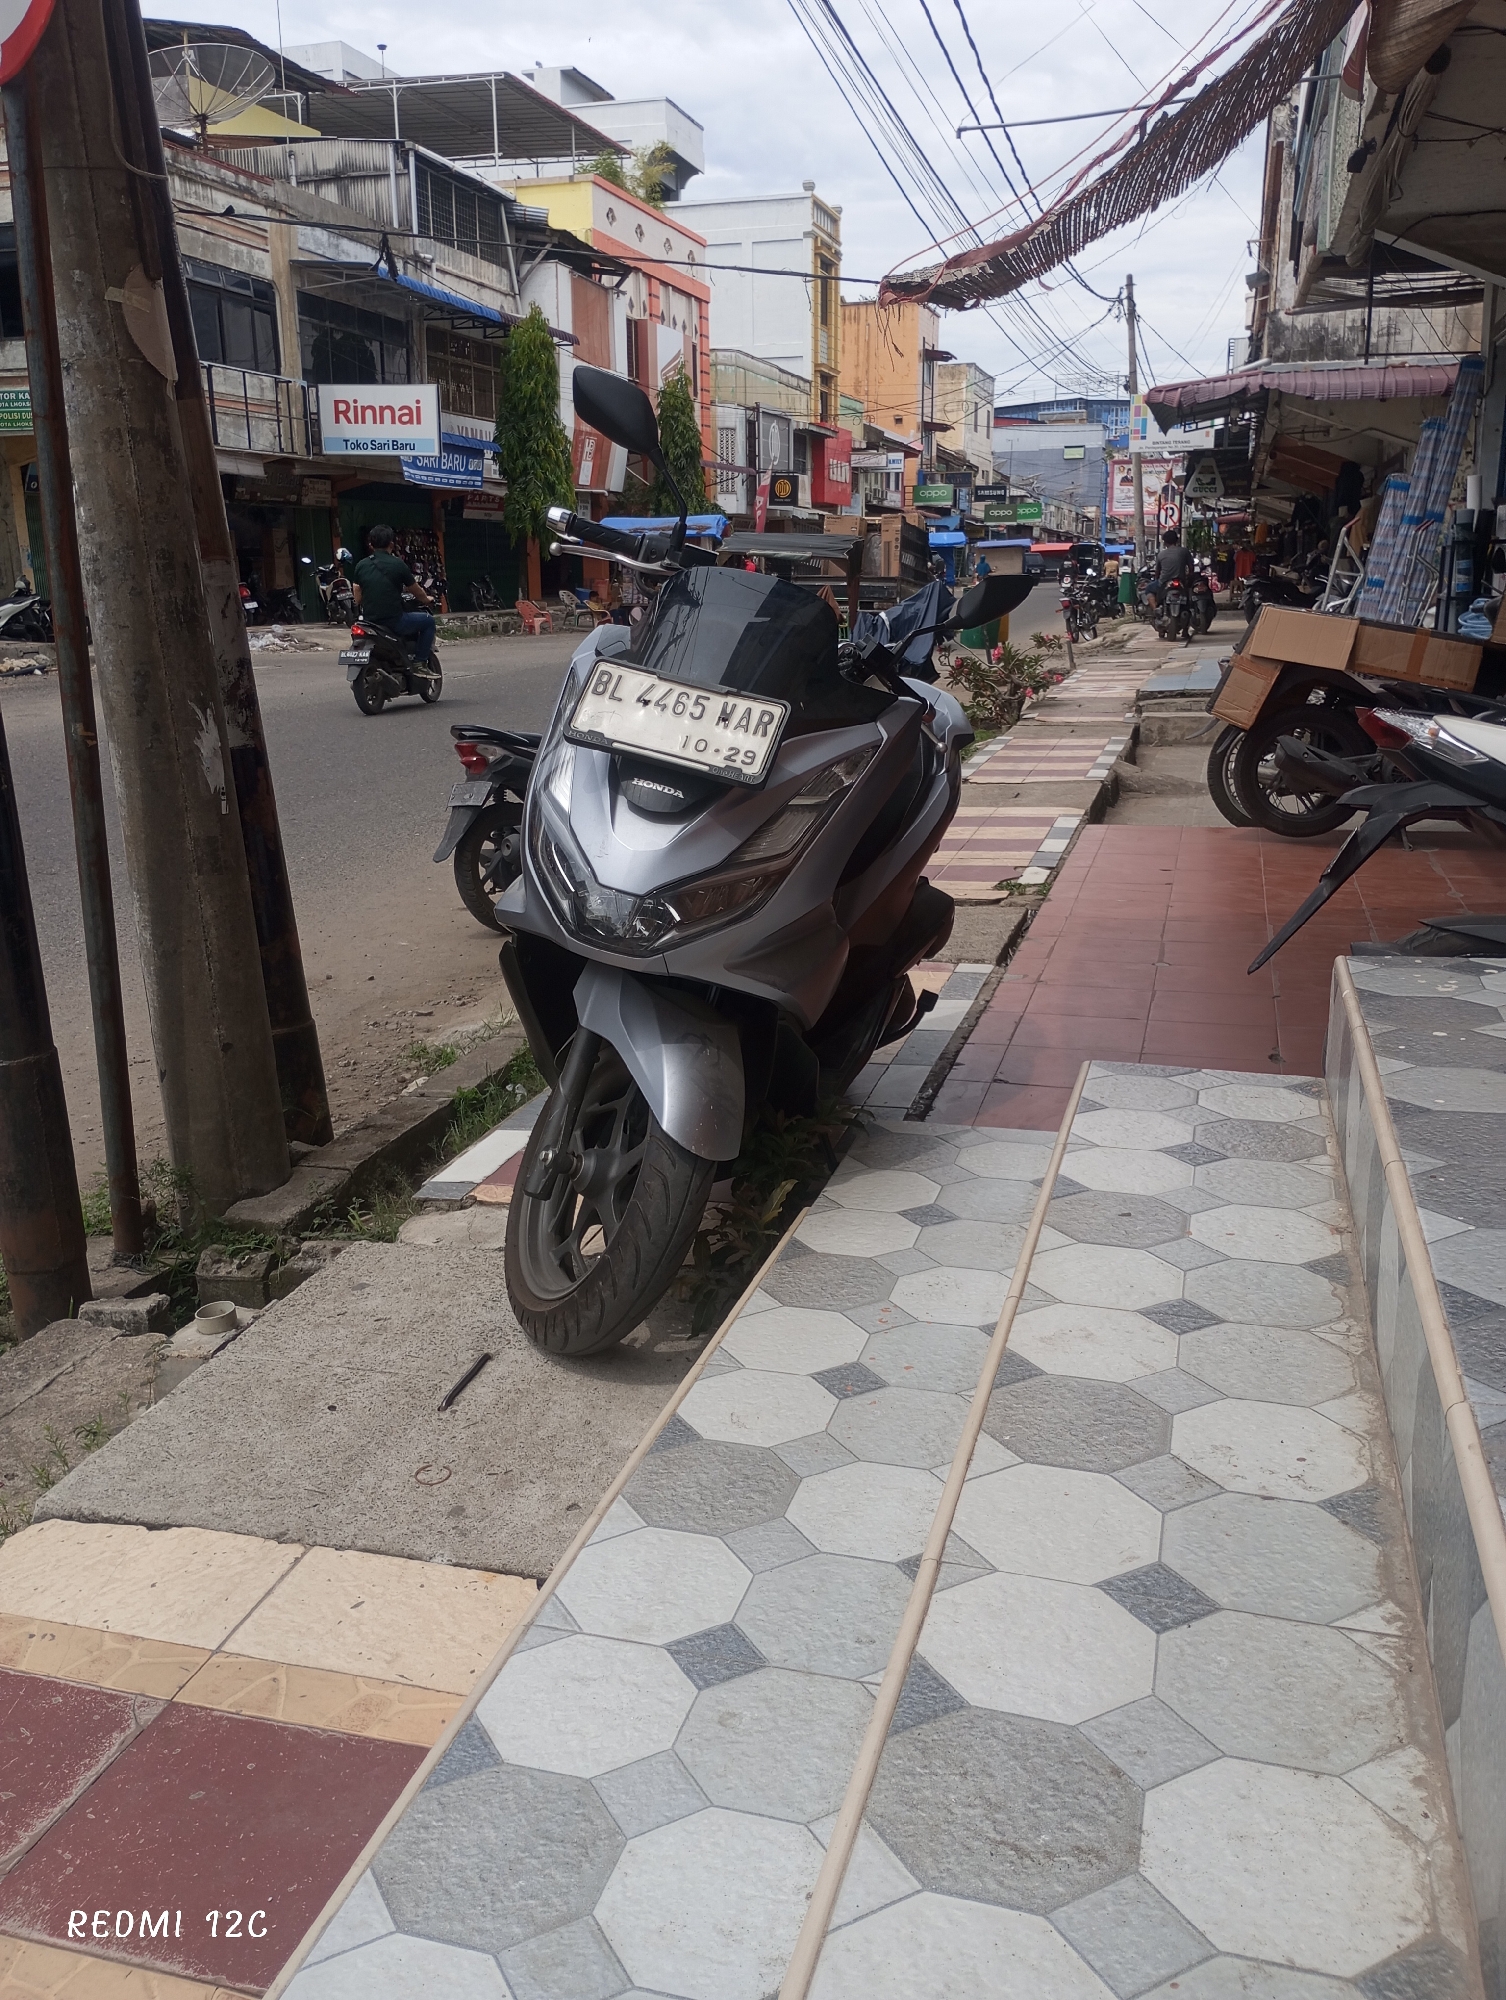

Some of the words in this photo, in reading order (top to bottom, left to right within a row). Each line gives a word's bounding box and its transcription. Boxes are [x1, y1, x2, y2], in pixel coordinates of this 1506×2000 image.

[333, 398, 422, 426] Rinnai
[342, 439, 369, 451] Toko
[370, 439, 391, 451] Sari
[391, 439, 416, 451] Baru
[416, 456, 439, 468] SARI
[441, 452, 467, 472] BARU
[467, 494, 501, 503] PARTS
[919, 489, 948, 499] oppo
[989, 509, 1013, 517] oppo
[591, 670, 623, 702] BL
[635, 683, 711, 721] 4465
[568, 730, 609, 746] HONDA
[631, 777, 685, 799] HONDA
